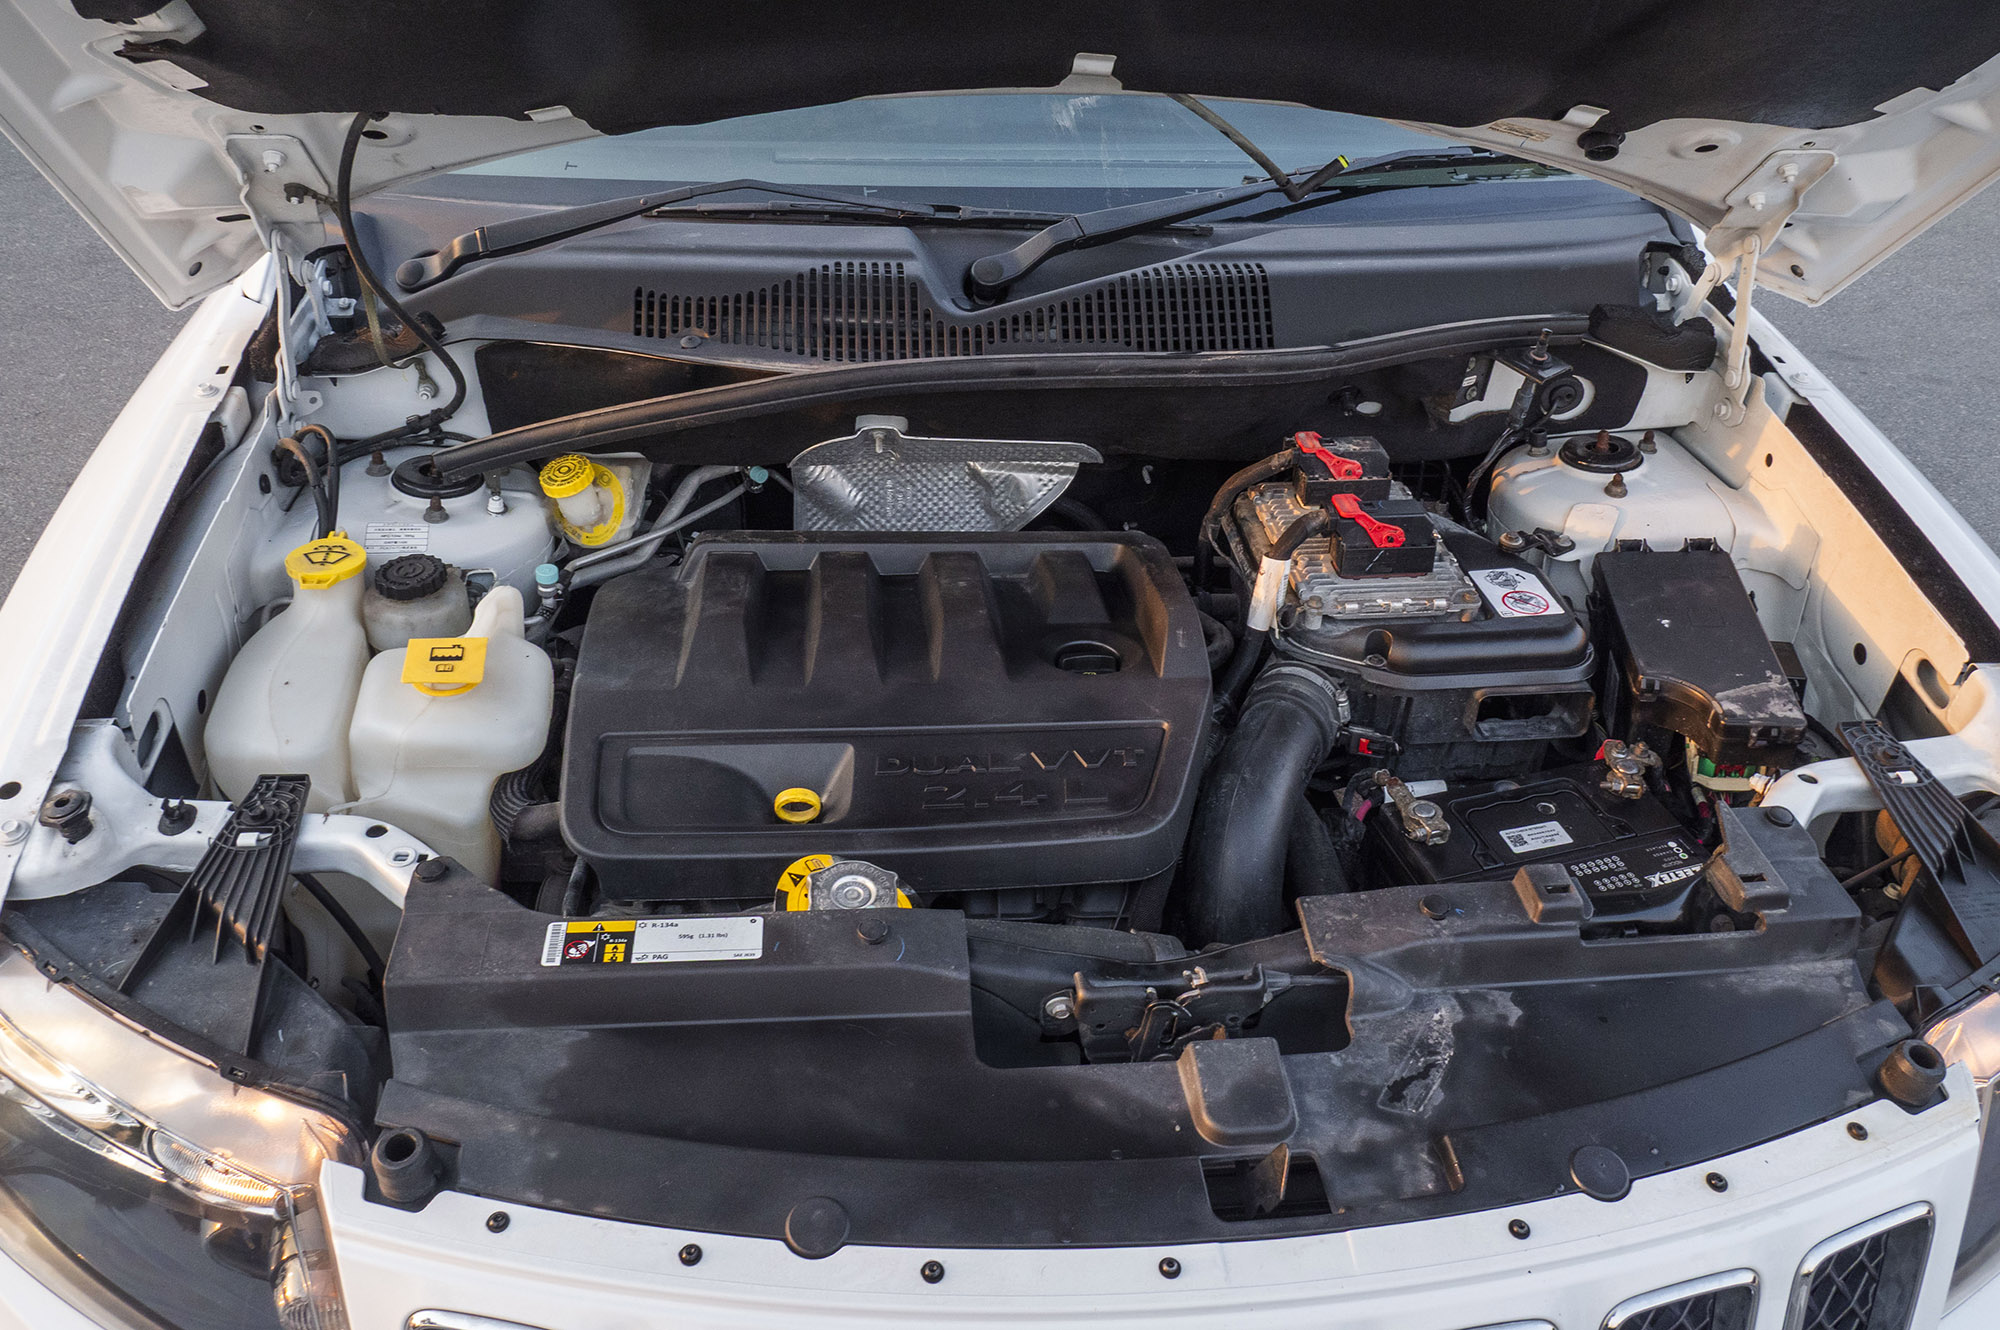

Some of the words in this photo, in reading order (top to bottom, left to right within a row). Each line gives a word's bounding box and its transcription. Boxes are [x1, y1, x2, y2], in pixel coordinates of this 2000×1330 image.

[874, 752, 1022, 776] DUAL
[1029, 747, 1145, 770] VVT
[652, 953, 669, 961] PAG
